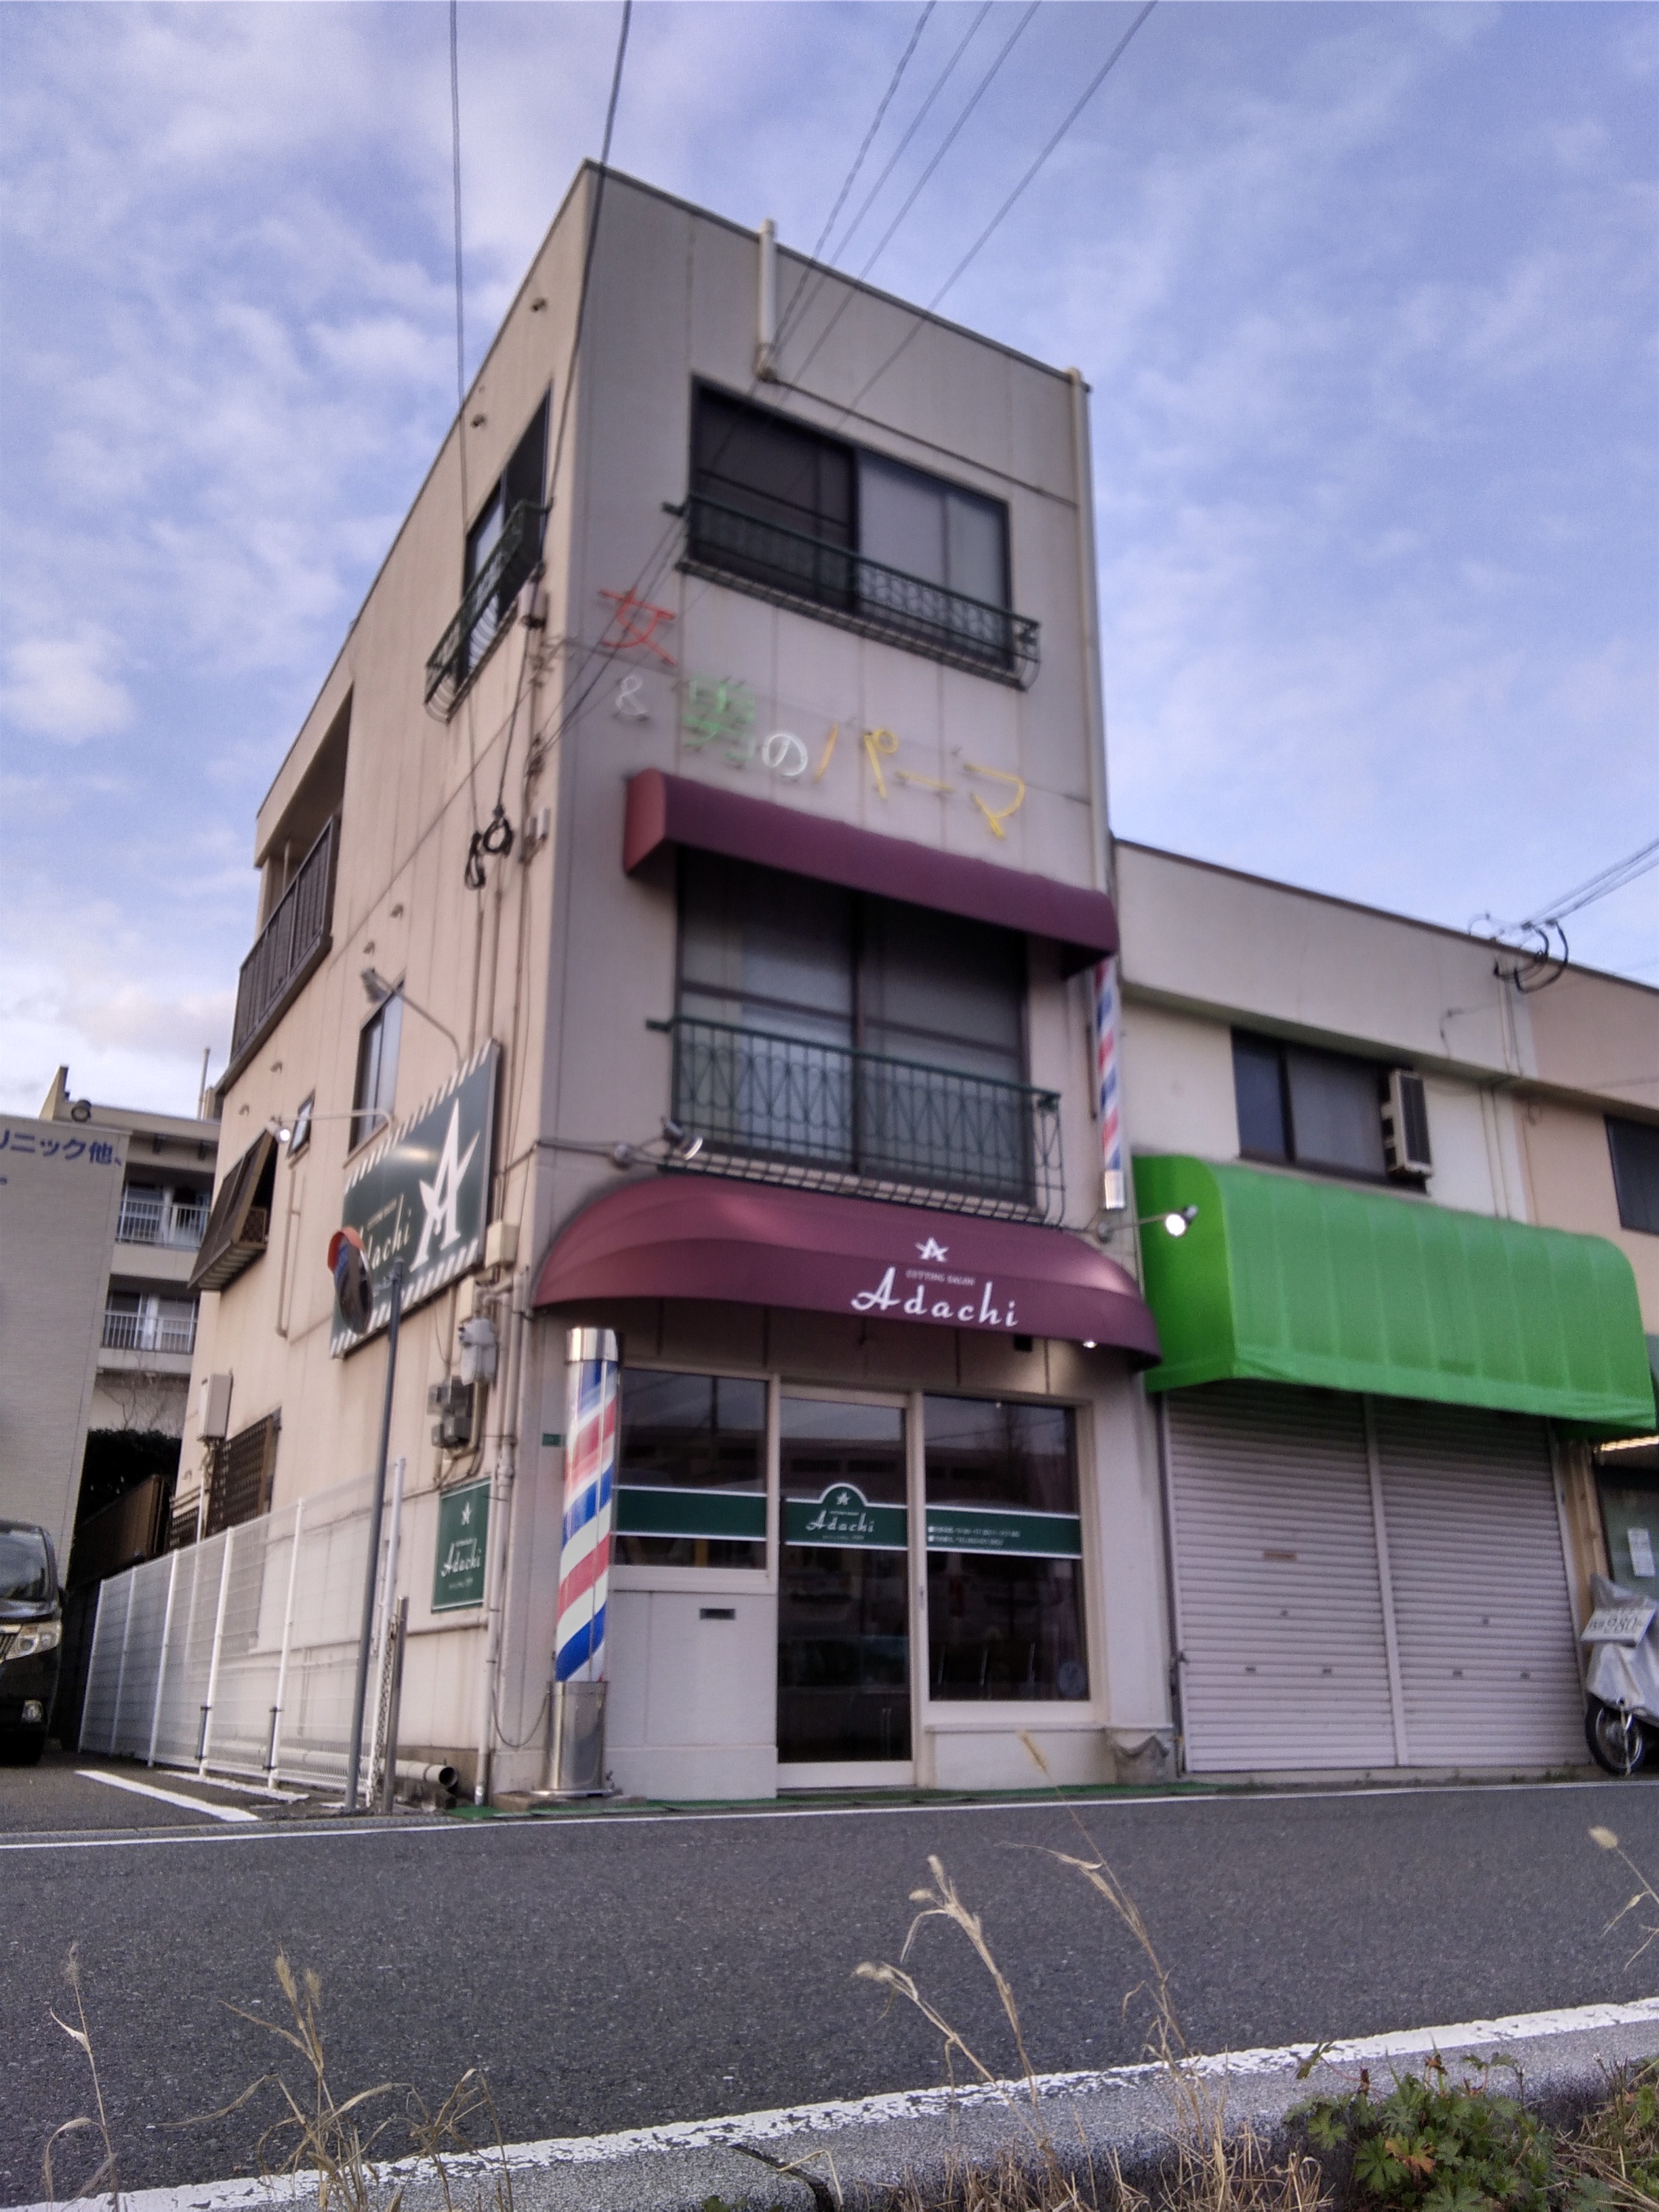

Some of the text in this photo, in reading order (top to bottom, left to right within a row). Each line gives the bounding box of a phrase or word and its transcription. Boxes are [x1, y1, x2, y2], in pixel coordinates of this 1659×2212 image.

[598, 586, 675, 665] 女
[851, 1265, 1019, 1327] Adachi
[805, 1510, 875, 1533] Adachi
[441, 1538, 482, 1577] Adachi
